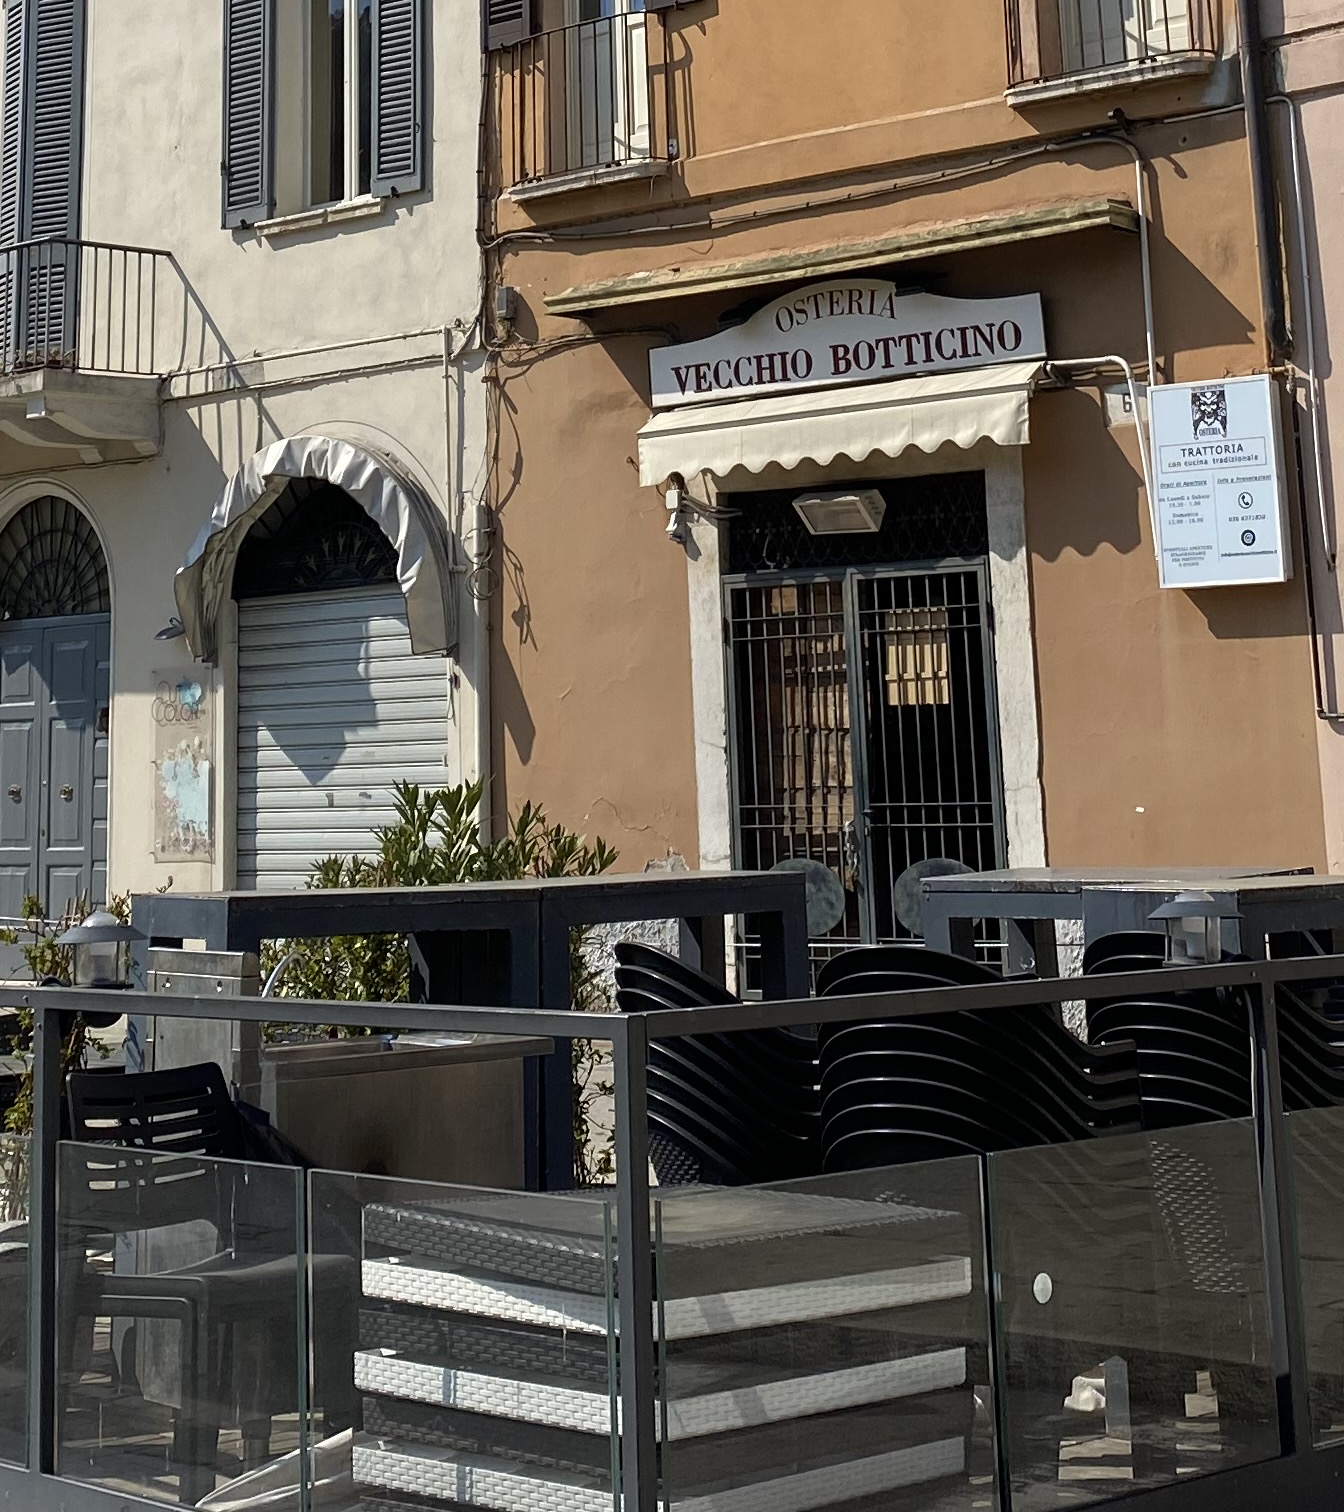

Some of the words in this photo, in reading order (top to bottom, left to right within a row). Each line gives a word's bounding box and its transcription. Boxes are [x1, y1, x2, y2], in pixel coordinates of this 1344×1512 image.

[775, 288, 897, 333] OSTERIA
[671, 348, 813, 396] VECCHIO
[829, 319, 1023, 376] BOTTICINO
[1122, 393, 1132, 413] 6
[1198, 427, 1222, 437] OSTERIA
[1180, 443, 1244, 458] TRATTORIA
[1184, 458, 1208, 467] cucina
[1212, 454, 1259, 465] tradizionale
